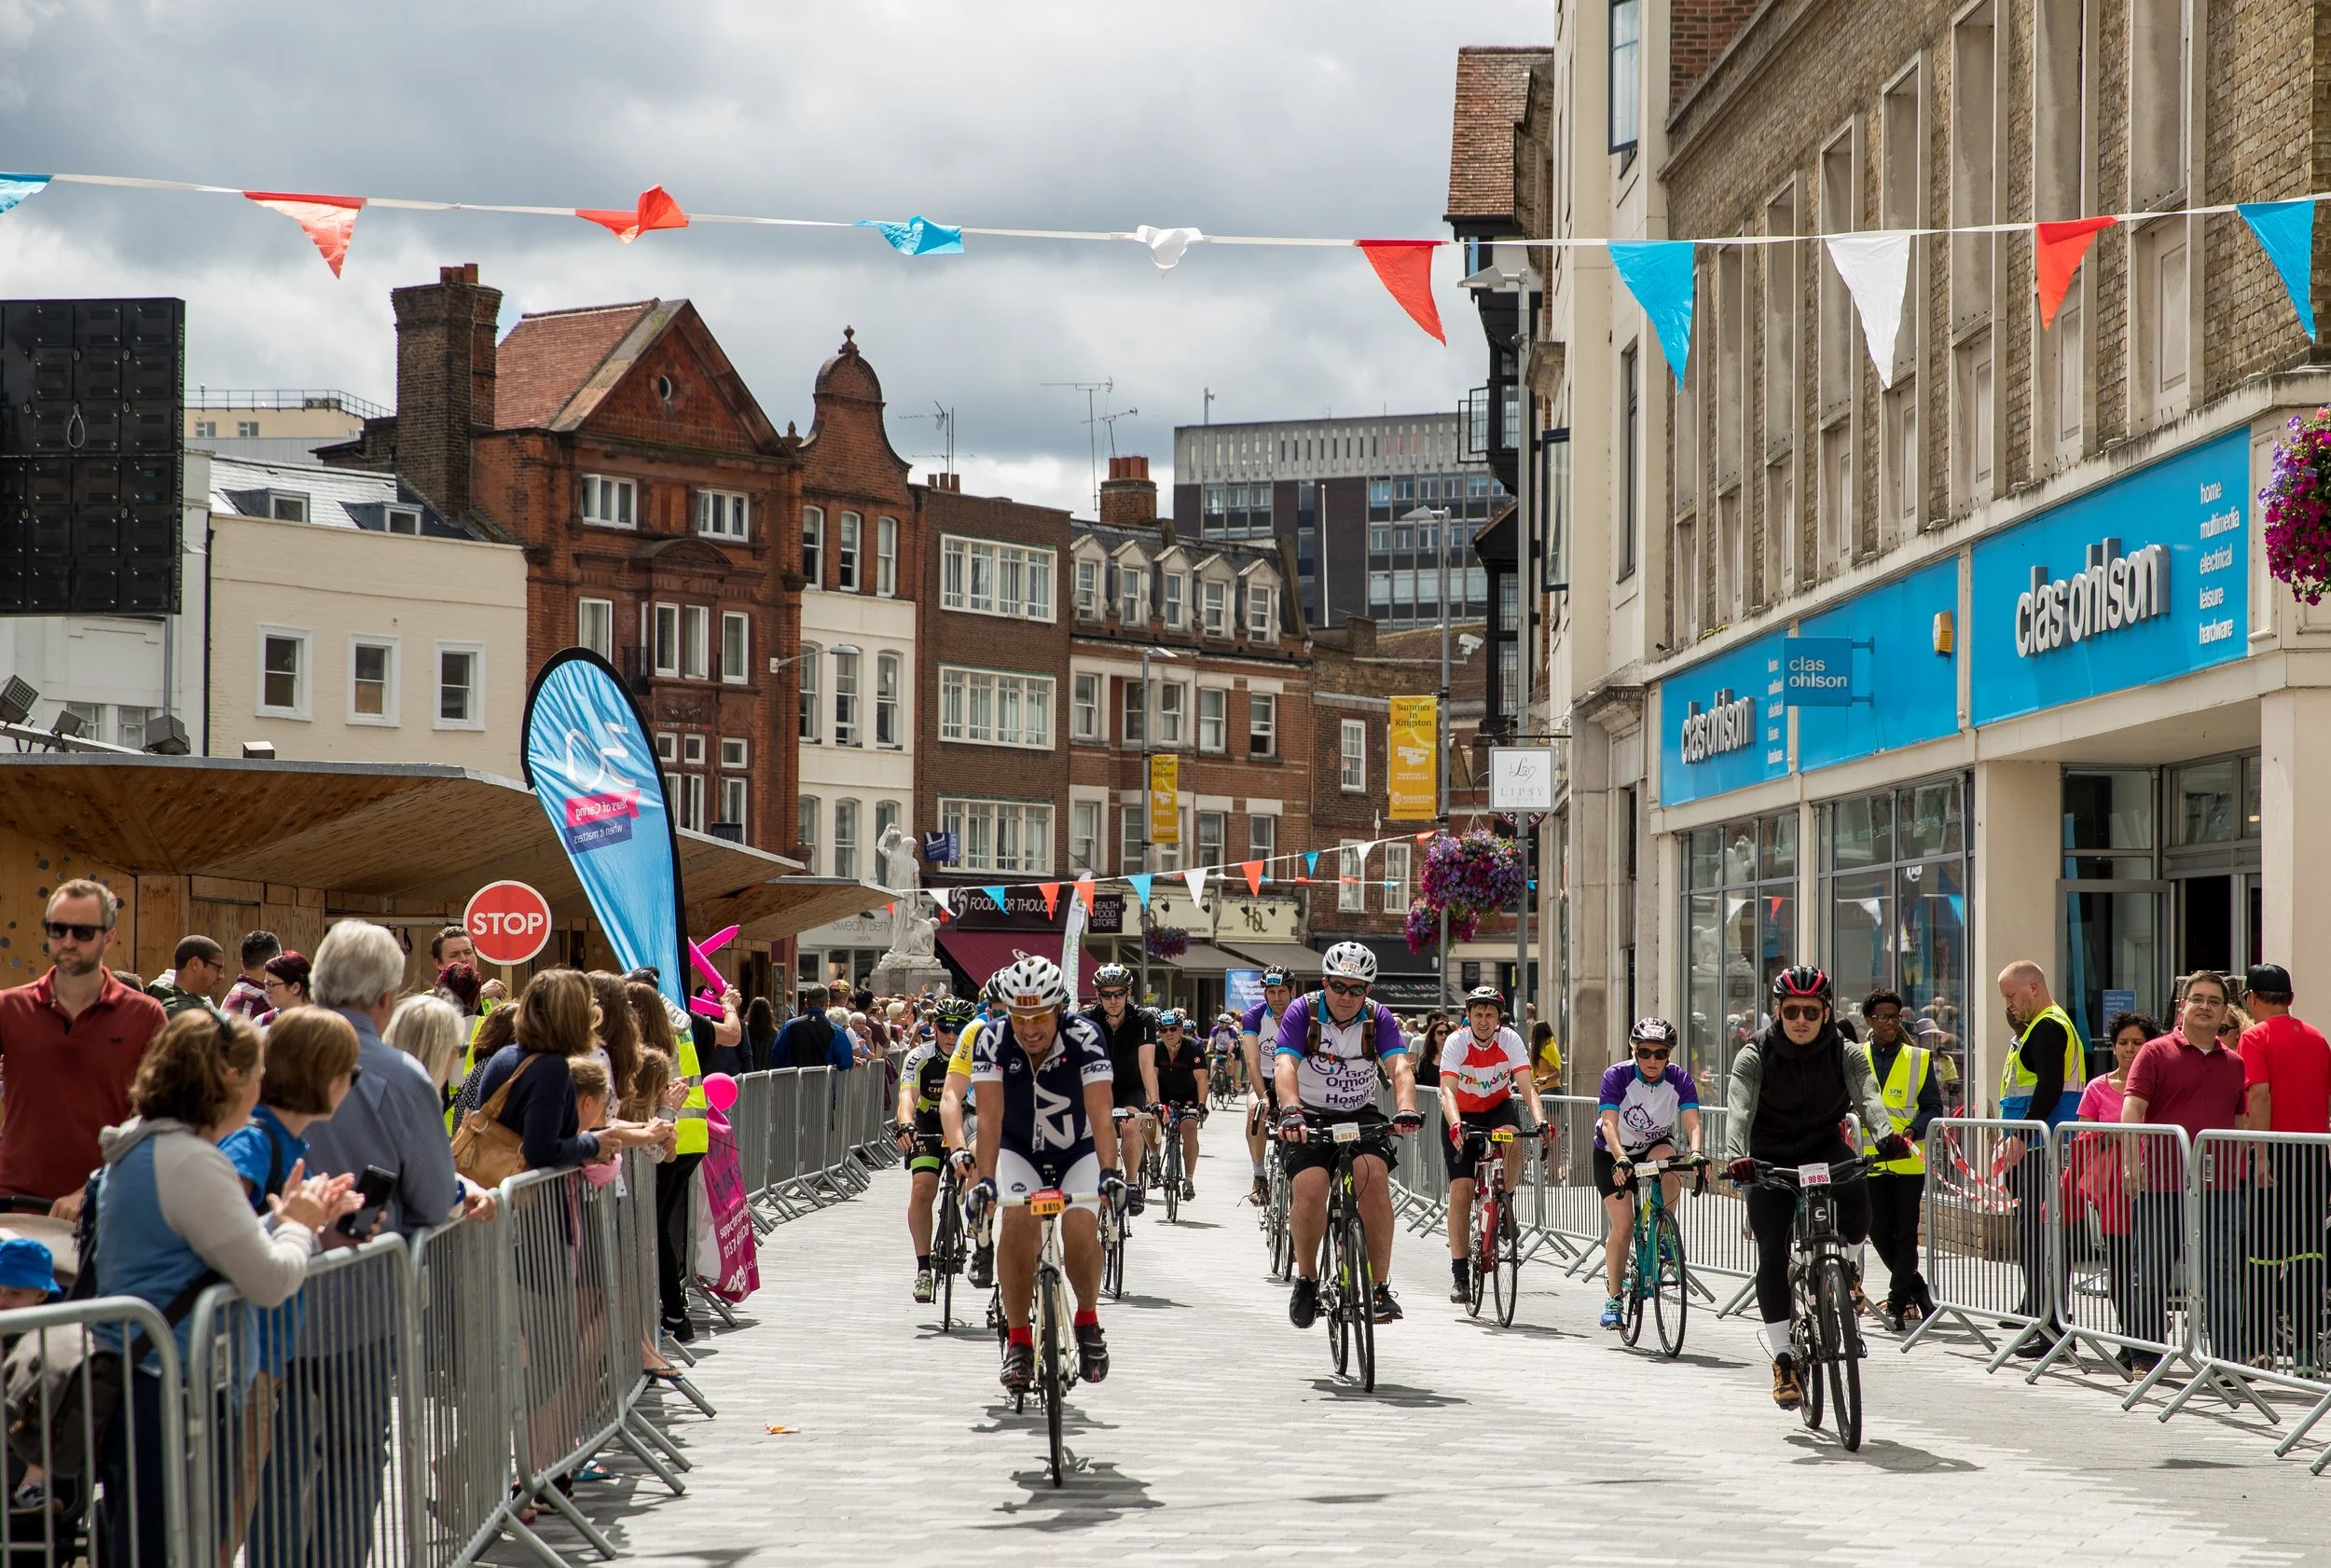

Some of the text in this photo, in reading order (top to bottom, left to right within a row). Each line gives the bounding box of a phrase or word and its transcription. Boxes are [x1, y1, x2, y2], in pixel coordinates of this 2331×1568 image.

[2200, 481, 2222, 504] home
[2200, 505, 2241, 540] multimedia
[2200, 543, 2233, 574] electrical
[2015, 537, 2167, 658] clas ohlson
[2199, 586, 2224, 611] leisure
[2199, 619, 2234, 645] hardware
[1789, 656, 1826, 672] clas
[1789, 672, 1848, 688] ohlson
[1396, 703, 1431, 711] Summer
[1409, 710, 1418, 719] in
[1395, 718, 1433, 729] Kingston
[1681, 688, 1750, 764] clas ohlson
[1500, 787, 1545, 797] LIPSY
[970, 897, 996, 911] FOOD
[1016, 898, 1060, 913] THOUGT
[1095, 909, 1116, 918] FOOD
[472, 912, 545, 935] STOP
[833, 917, 891, 935] Sweaty Betty
[1092, 917, 1119, 928] STORE
[1326, 1073, 1376, 1088] Ormon
[1042, 1203, 1061, 1212] 9615
